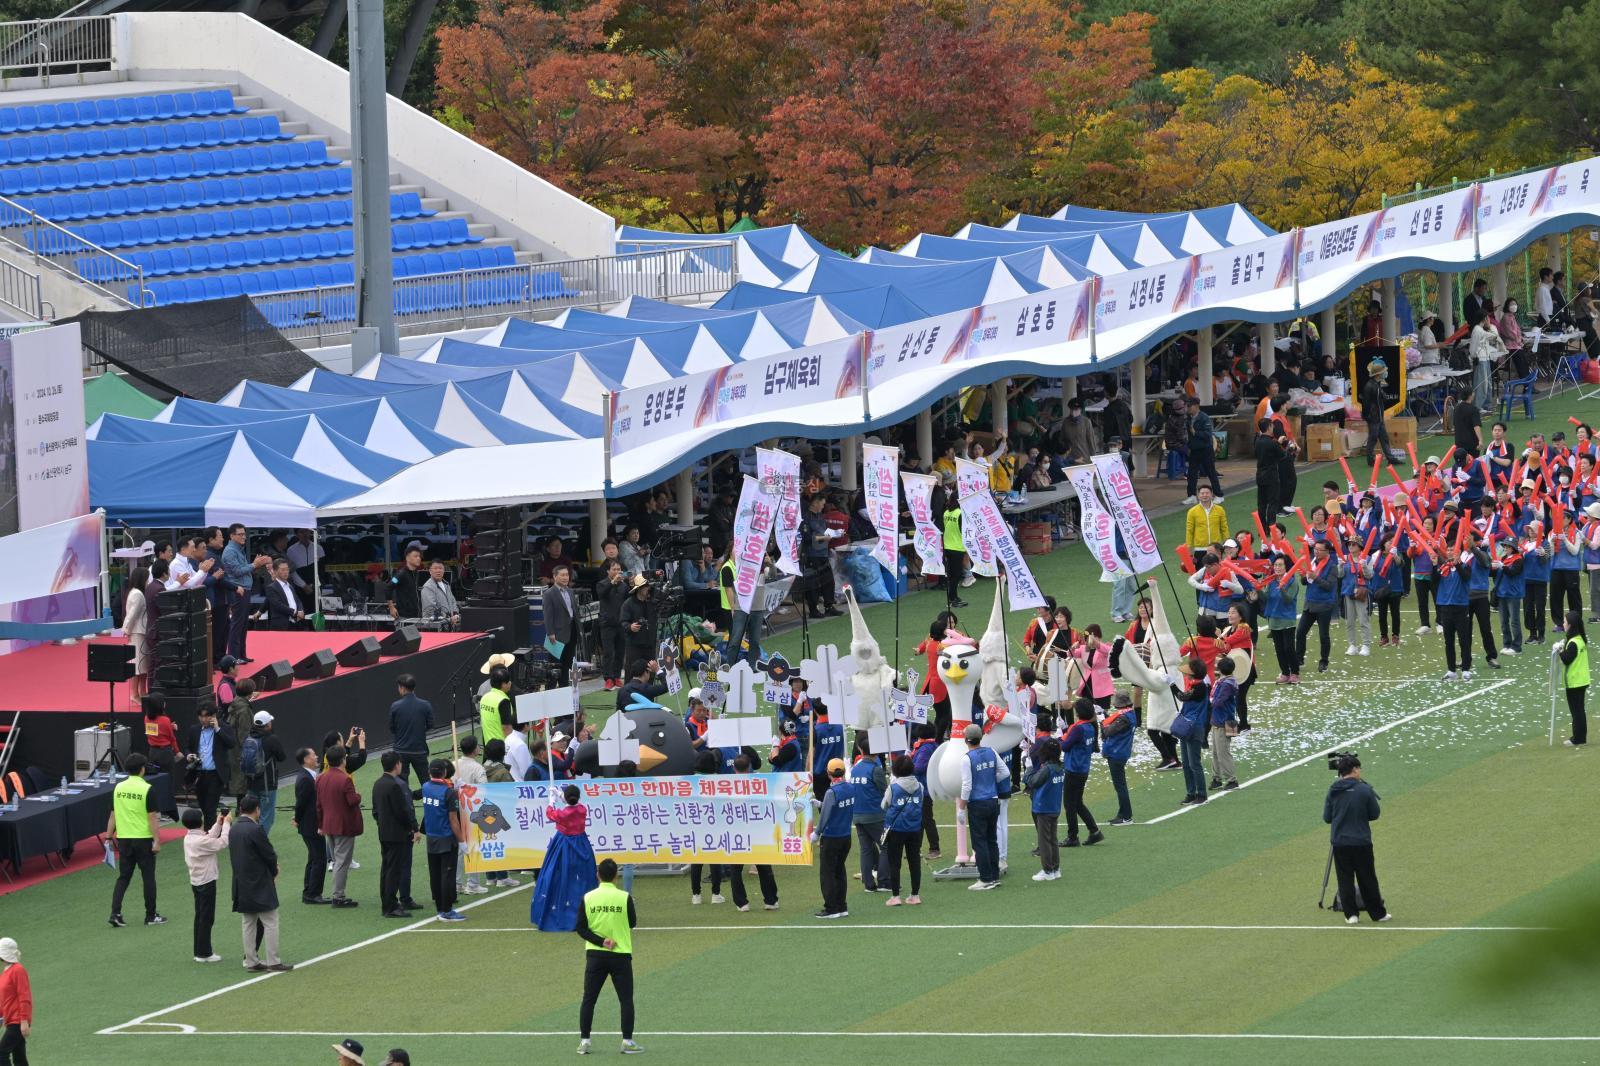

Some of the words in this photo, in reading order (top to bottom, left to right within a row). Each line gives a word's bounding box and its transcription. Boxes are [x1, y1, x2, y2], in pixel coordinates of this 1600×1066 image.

[1410, 204, 1444, 237] 선암동
[1232, 251, 1265, 286] 출입구
[1128, 274, 1166, 310] 신정4동
[1016, 300, 1056, 337] 삼호동
[898, 326, 941, 363] 삼산동
[764, 355, 821, 396] 남구체육회
[643, 384, 687, 427] 운영본부
[976, 760, 995, 771] 삼호동
[584, 782, 635, 797] 남구민
[641, 780, 692, 797] 한마음
[699, 778, 768, 797] 체육대회
[612, 802, 670, 826] 공생하는
[674, 801, 716, 825] 친환경
[721, 801, 776, 825] 생태도시
[480, 842, 504, 859] 삼삼
[632, 833, 662, 854] 모두
[667, 831, 696, 855] 놀러
[702, 832, 751, 854] 오세요!
[783, 837, 802, 853] 호호
[590, 905, 623, 914] 남구체육회
